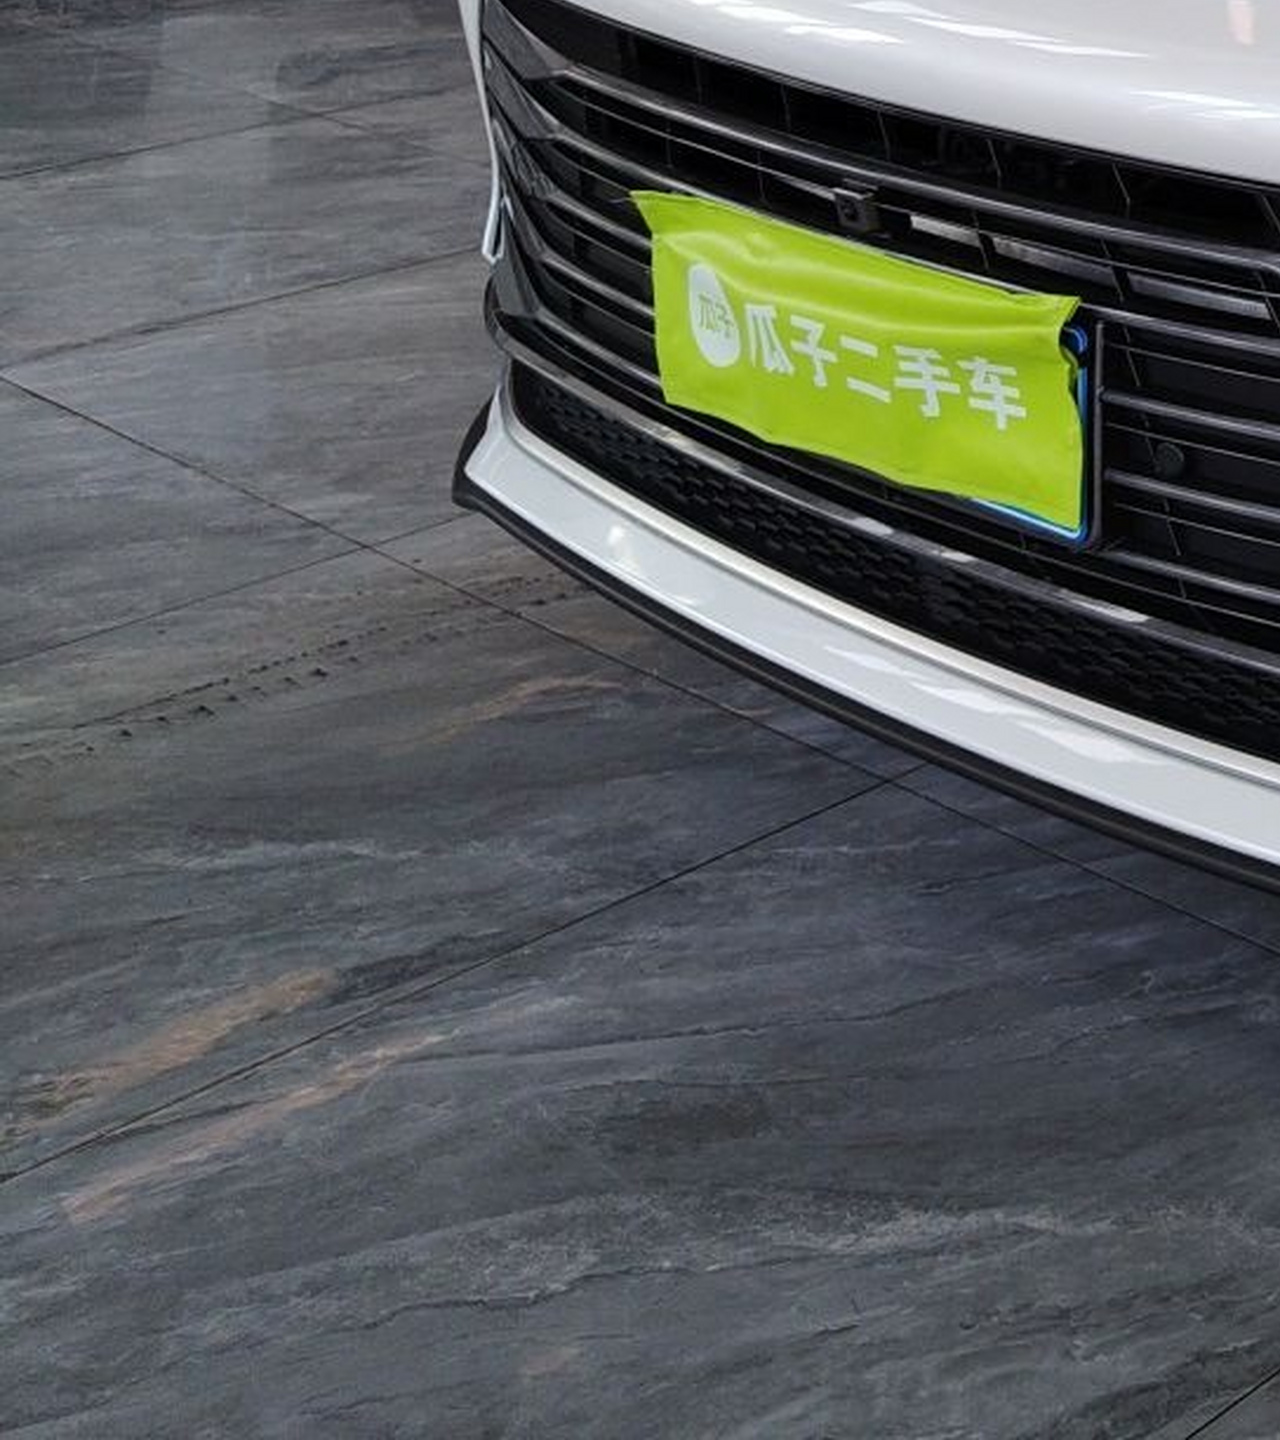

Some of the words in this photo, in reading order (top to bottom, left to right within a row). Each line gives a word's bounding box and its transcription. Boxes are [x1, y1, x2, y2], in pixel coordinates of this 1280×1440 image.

[745, 302, 1027, 431] 瓜子二手车
